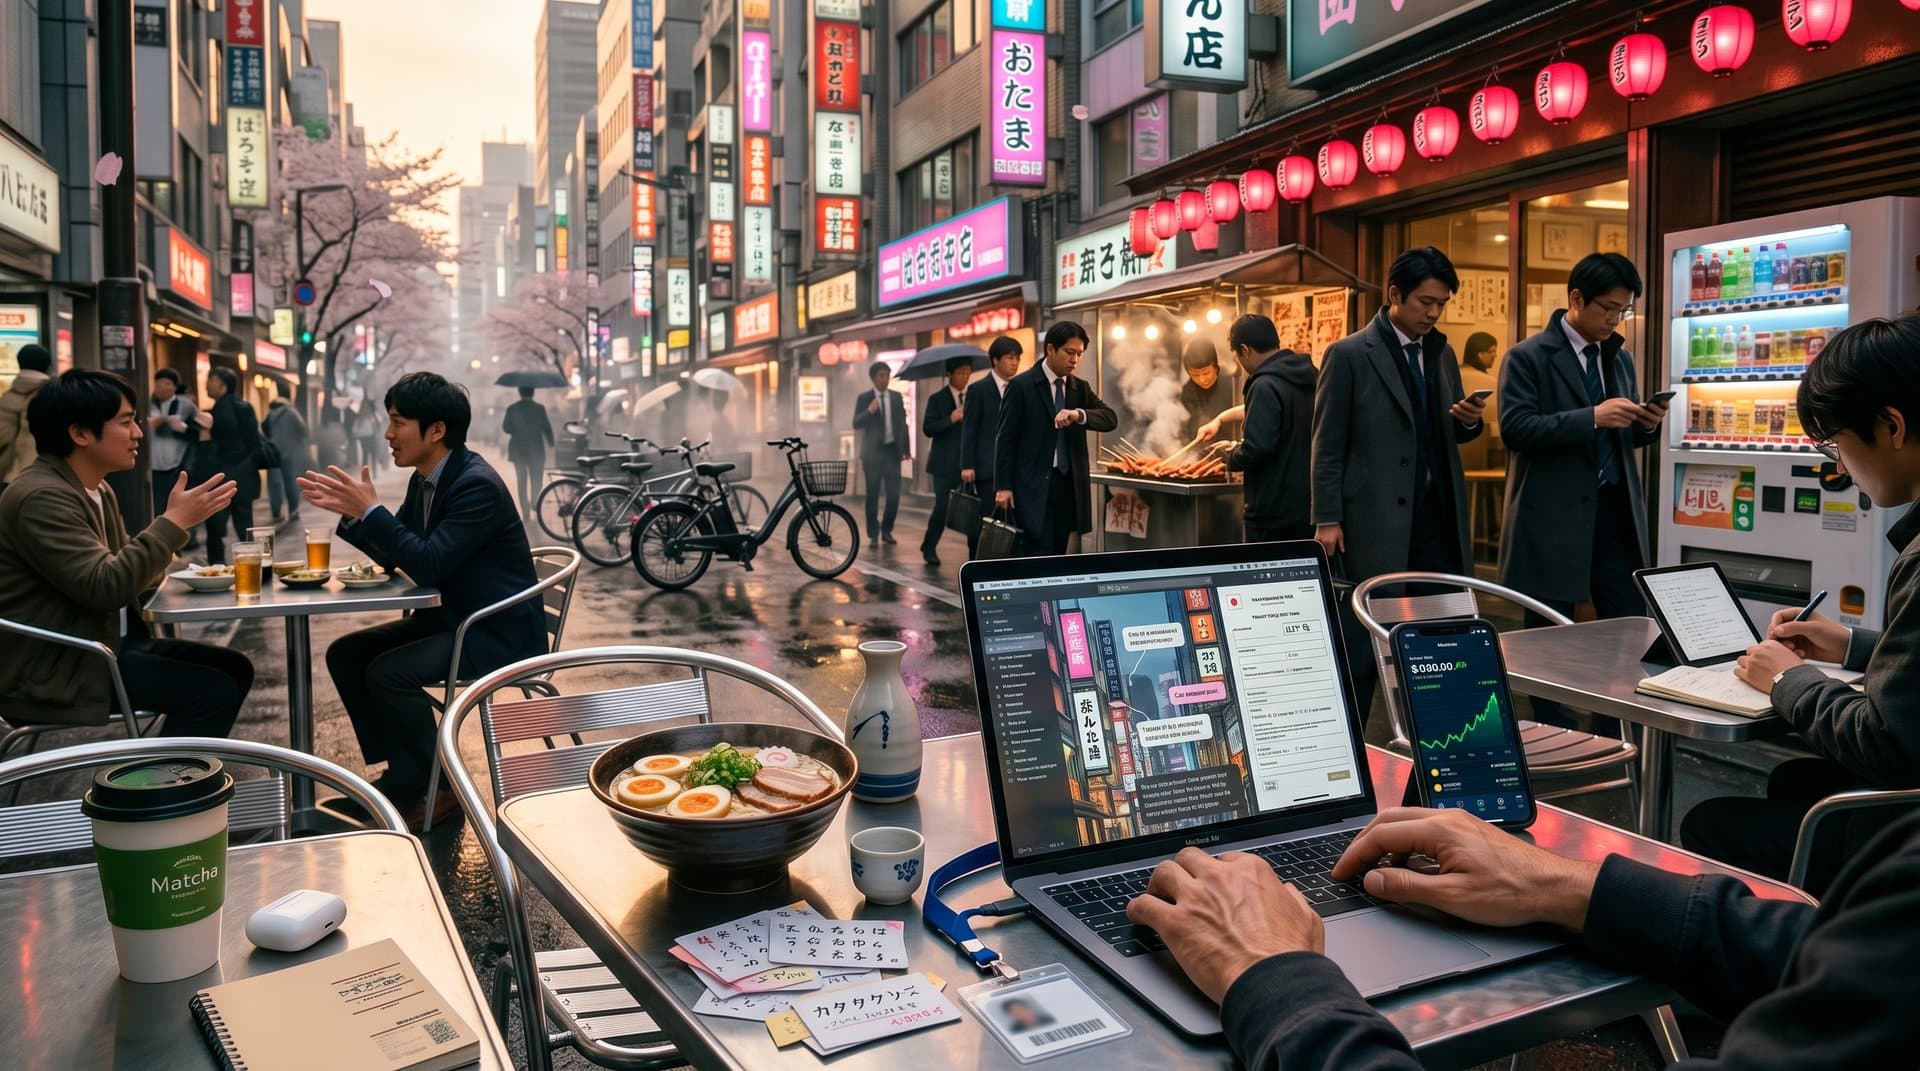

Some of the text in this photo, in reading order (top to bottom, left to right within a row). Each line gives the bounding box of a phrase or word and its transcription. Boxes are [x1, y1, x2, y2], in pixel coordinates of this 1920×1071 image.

[1004, 41, 1033, 151] おたま
[151, 866, 218, 894] Matcha
